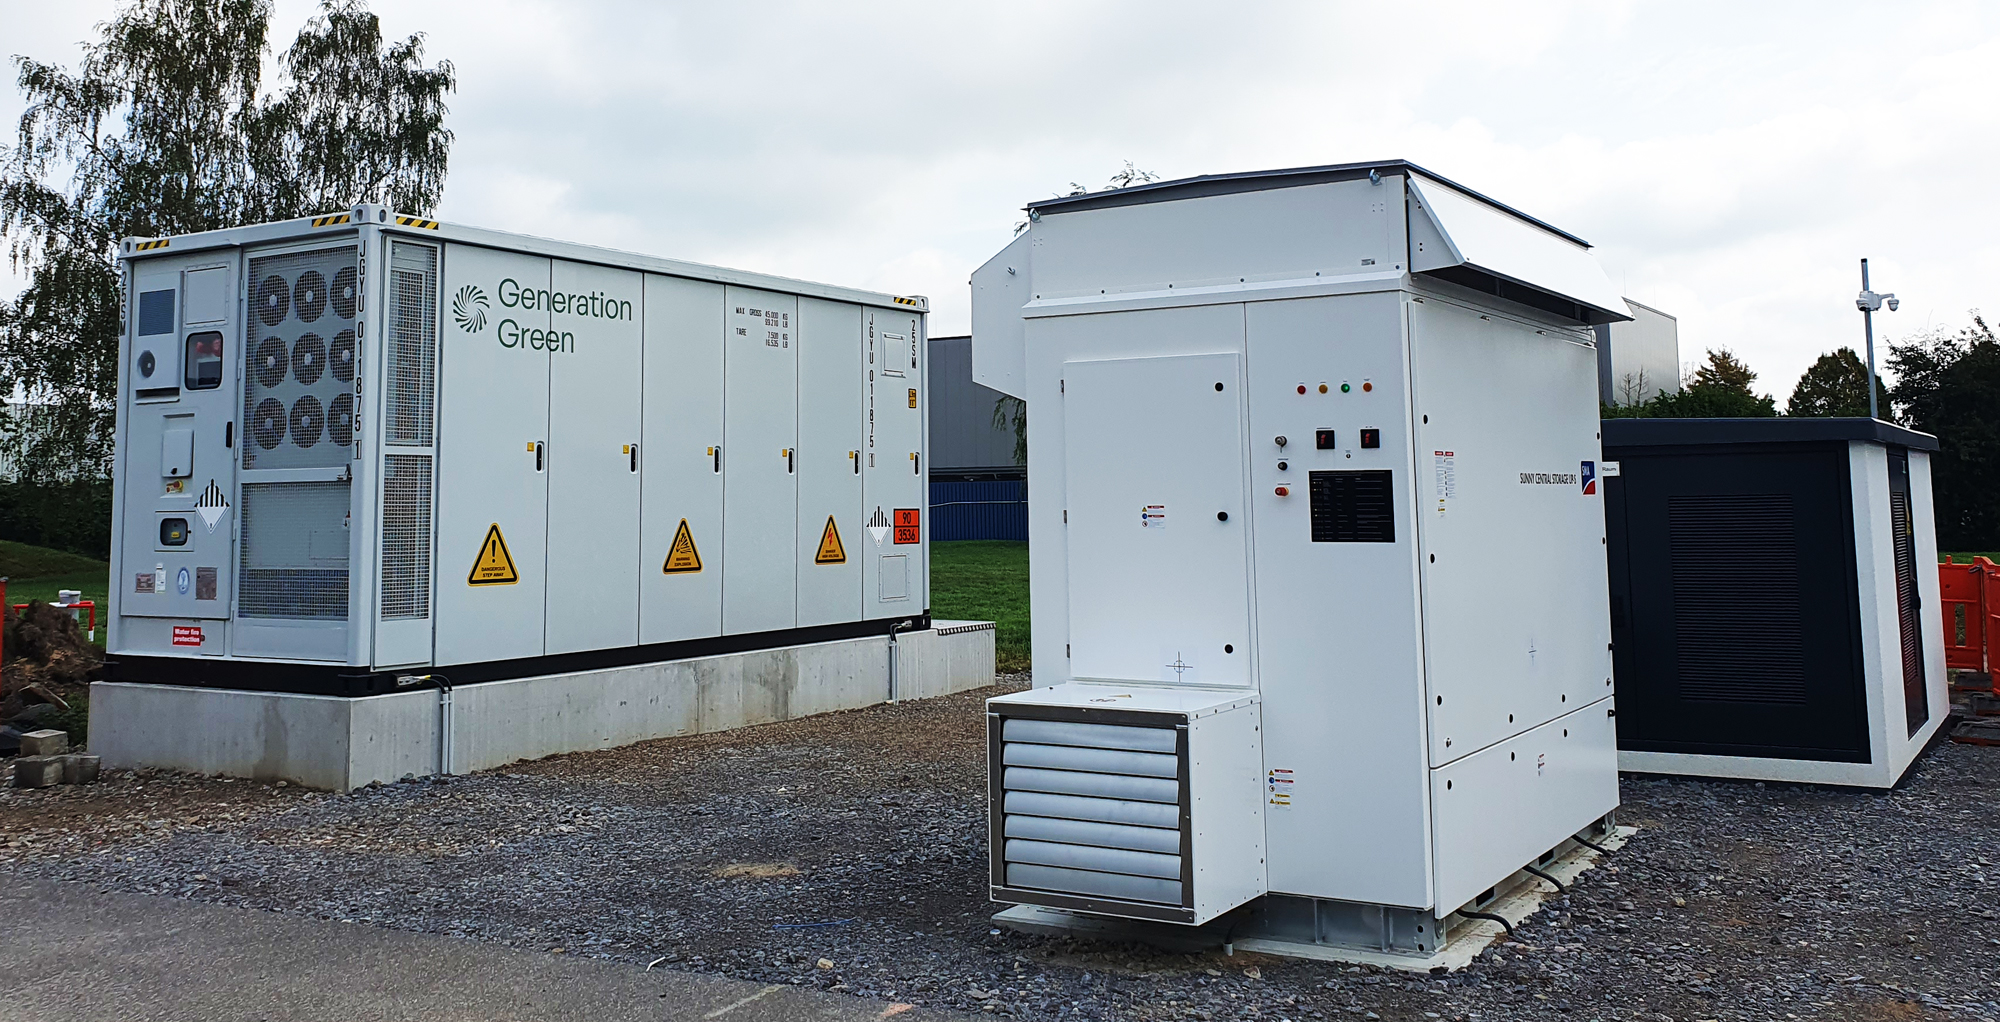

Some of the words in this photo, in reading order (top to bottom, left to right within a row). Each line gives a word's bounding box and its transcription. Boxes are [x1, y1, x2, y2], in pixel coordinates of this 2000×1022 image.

[498, 278, 632, 321] Generation
[497, 318, 574, 353] Green
[355, 321, 364, 432] 011875
[1520, 473, 1535, 484] SUNNY
[1535, 473, 1552, 484] CENTRAL
[1552, 473, 1569, 484] STORAGE
[902, 512, 912, 524] 90
[898, 529, 916, 541] 3536
